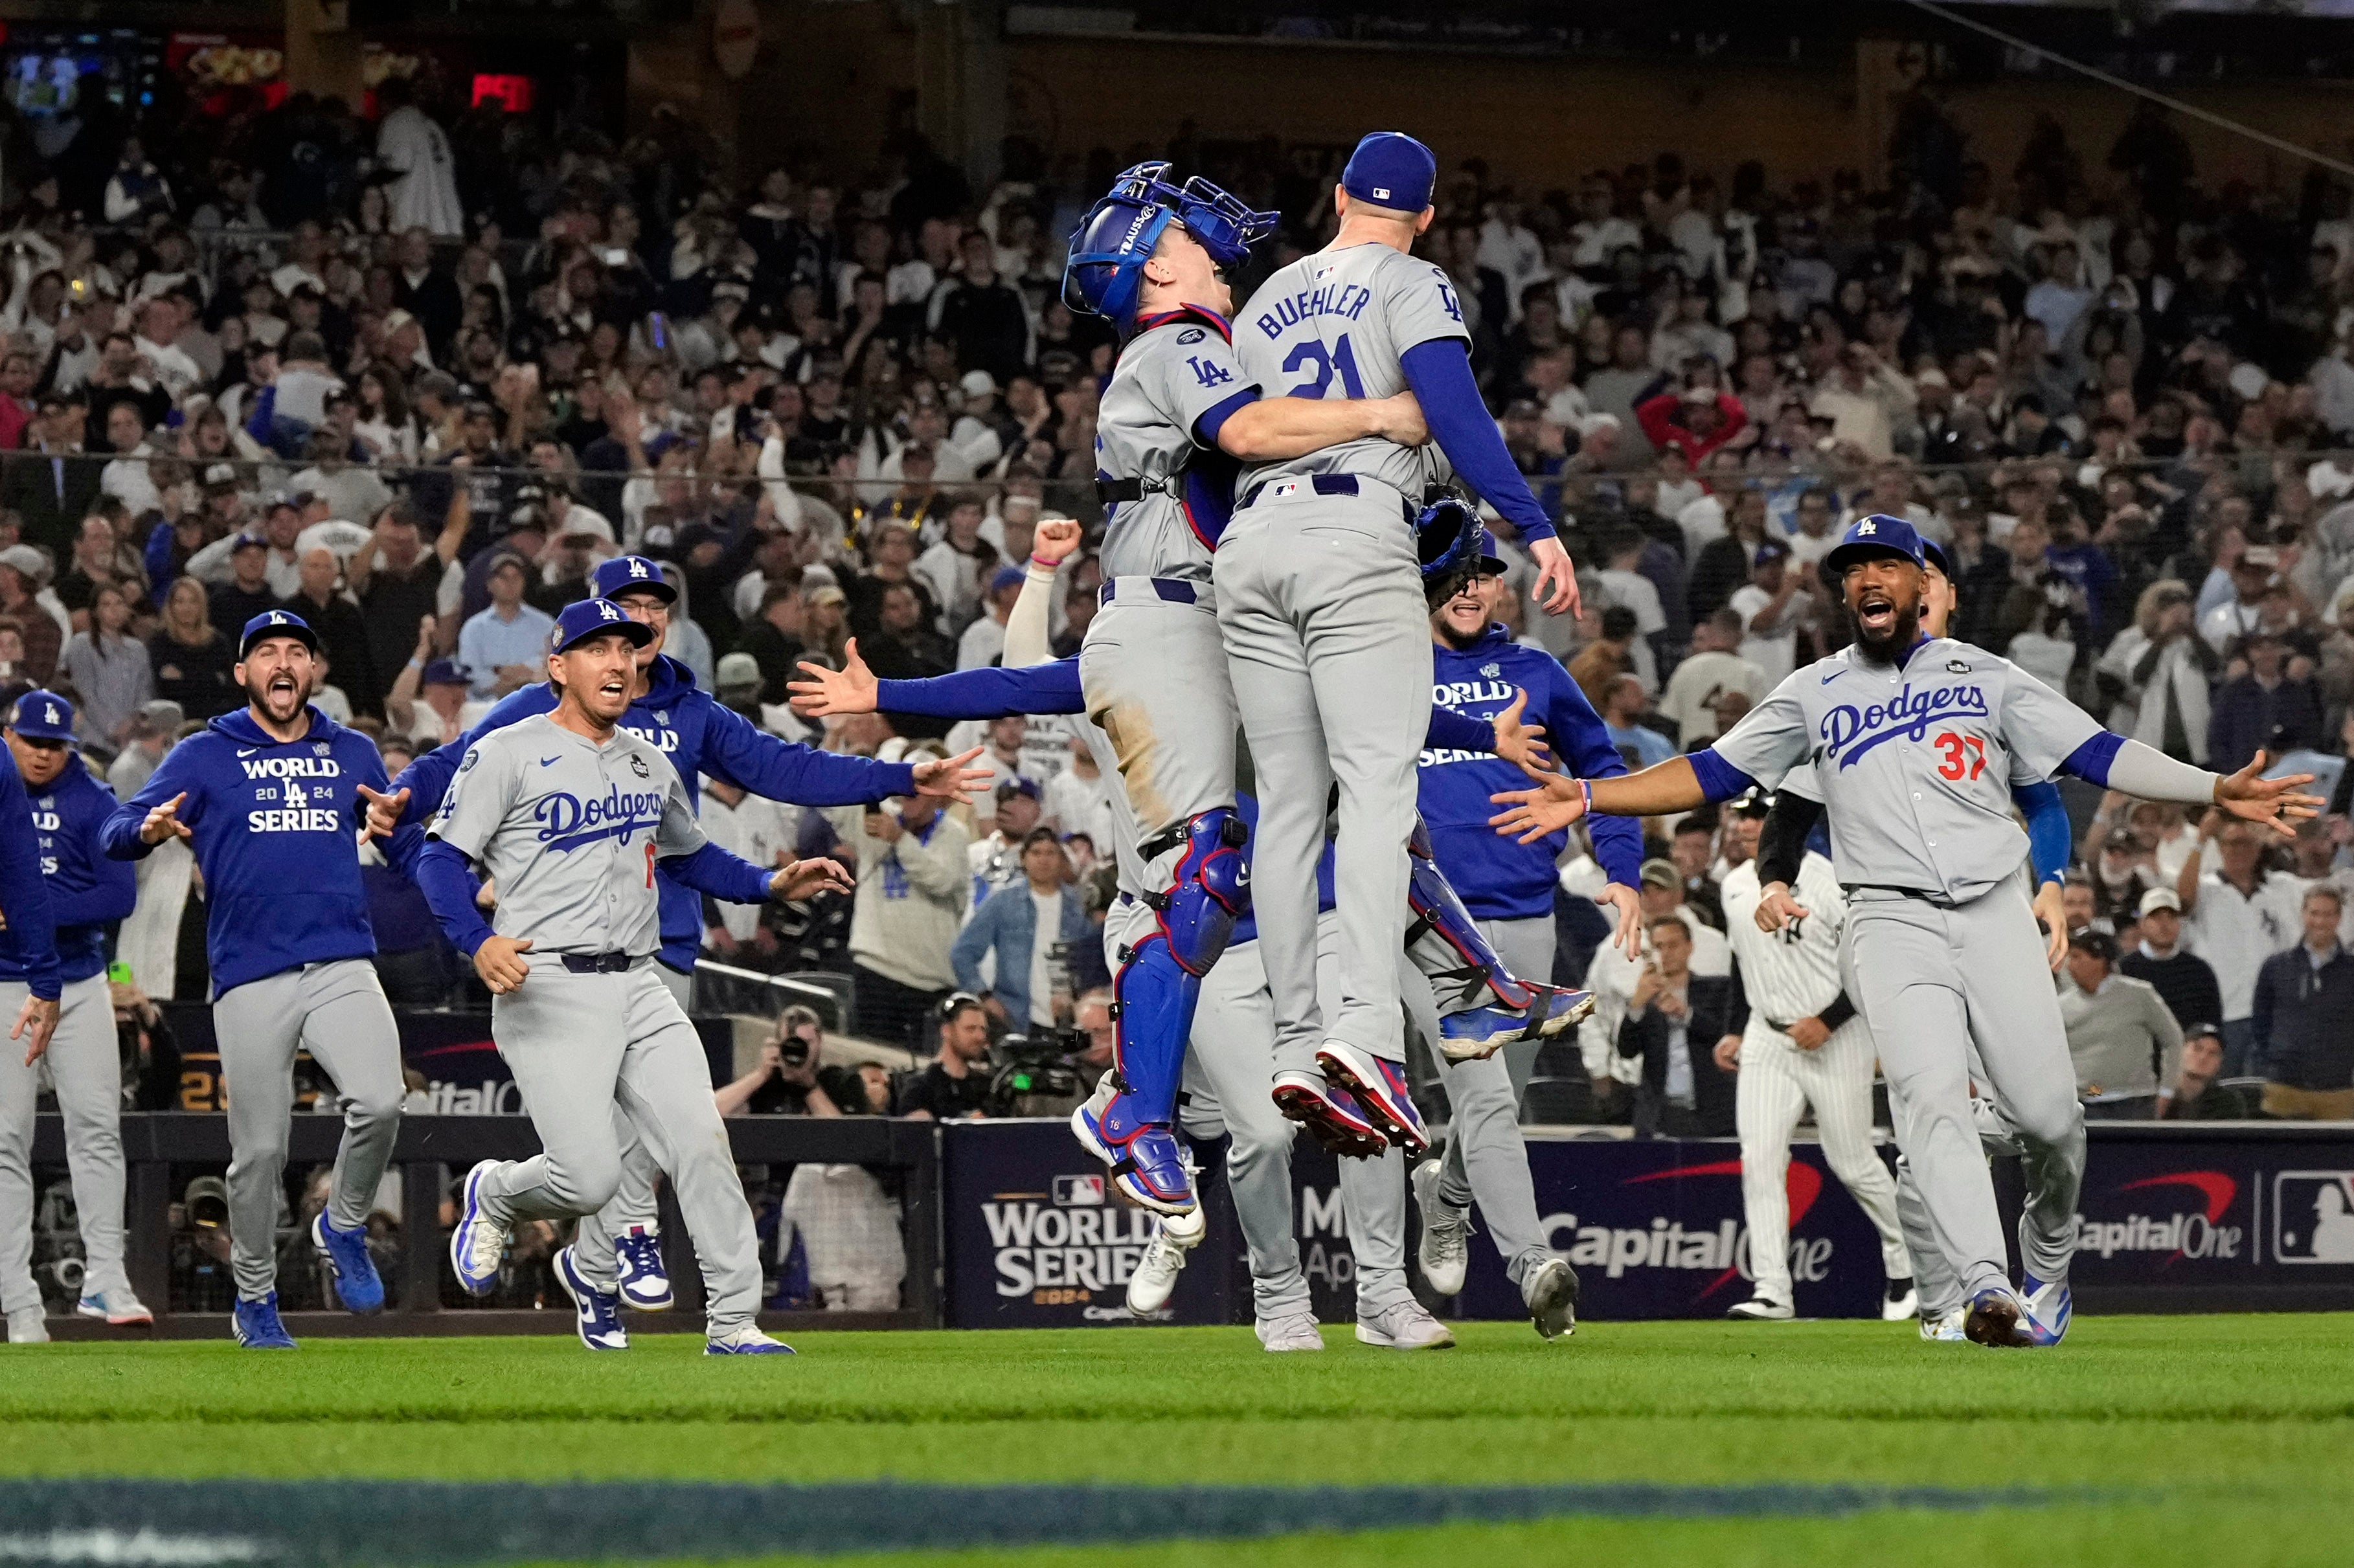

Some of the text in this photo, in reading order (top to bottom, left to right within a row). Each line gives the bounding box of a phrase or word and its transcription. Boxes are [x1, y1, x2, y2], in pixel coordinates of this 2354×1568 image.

[1119, 216, 1145, 255] TRAUSS
[1257, 283, 1370, 340] BUEHLER
[1186, 355, 1234, 387] LA
[1282, 332, 1366, 399] 21
[1857, 517, 1876, 536] LA
[627, 557, 648, 578] LA
[269, 610, 287, 625] LA
[595, 600, 619, 621] LA
[1432, 680, 1512, 705] ORLD
[44, 702, 60, 725] LA
[1820, 682, 1989, 761] Dodgers
[241, 757, 340, 779] WORLD
[1934, 732, 1987, 781] 37
[255, 777, 334, 808] 20 LA 24
[248, 809, 339, 833] SERIES
[1109, 1119, 1120, 1130] 16
[995, 1247, 1150, 1297] SERIE
